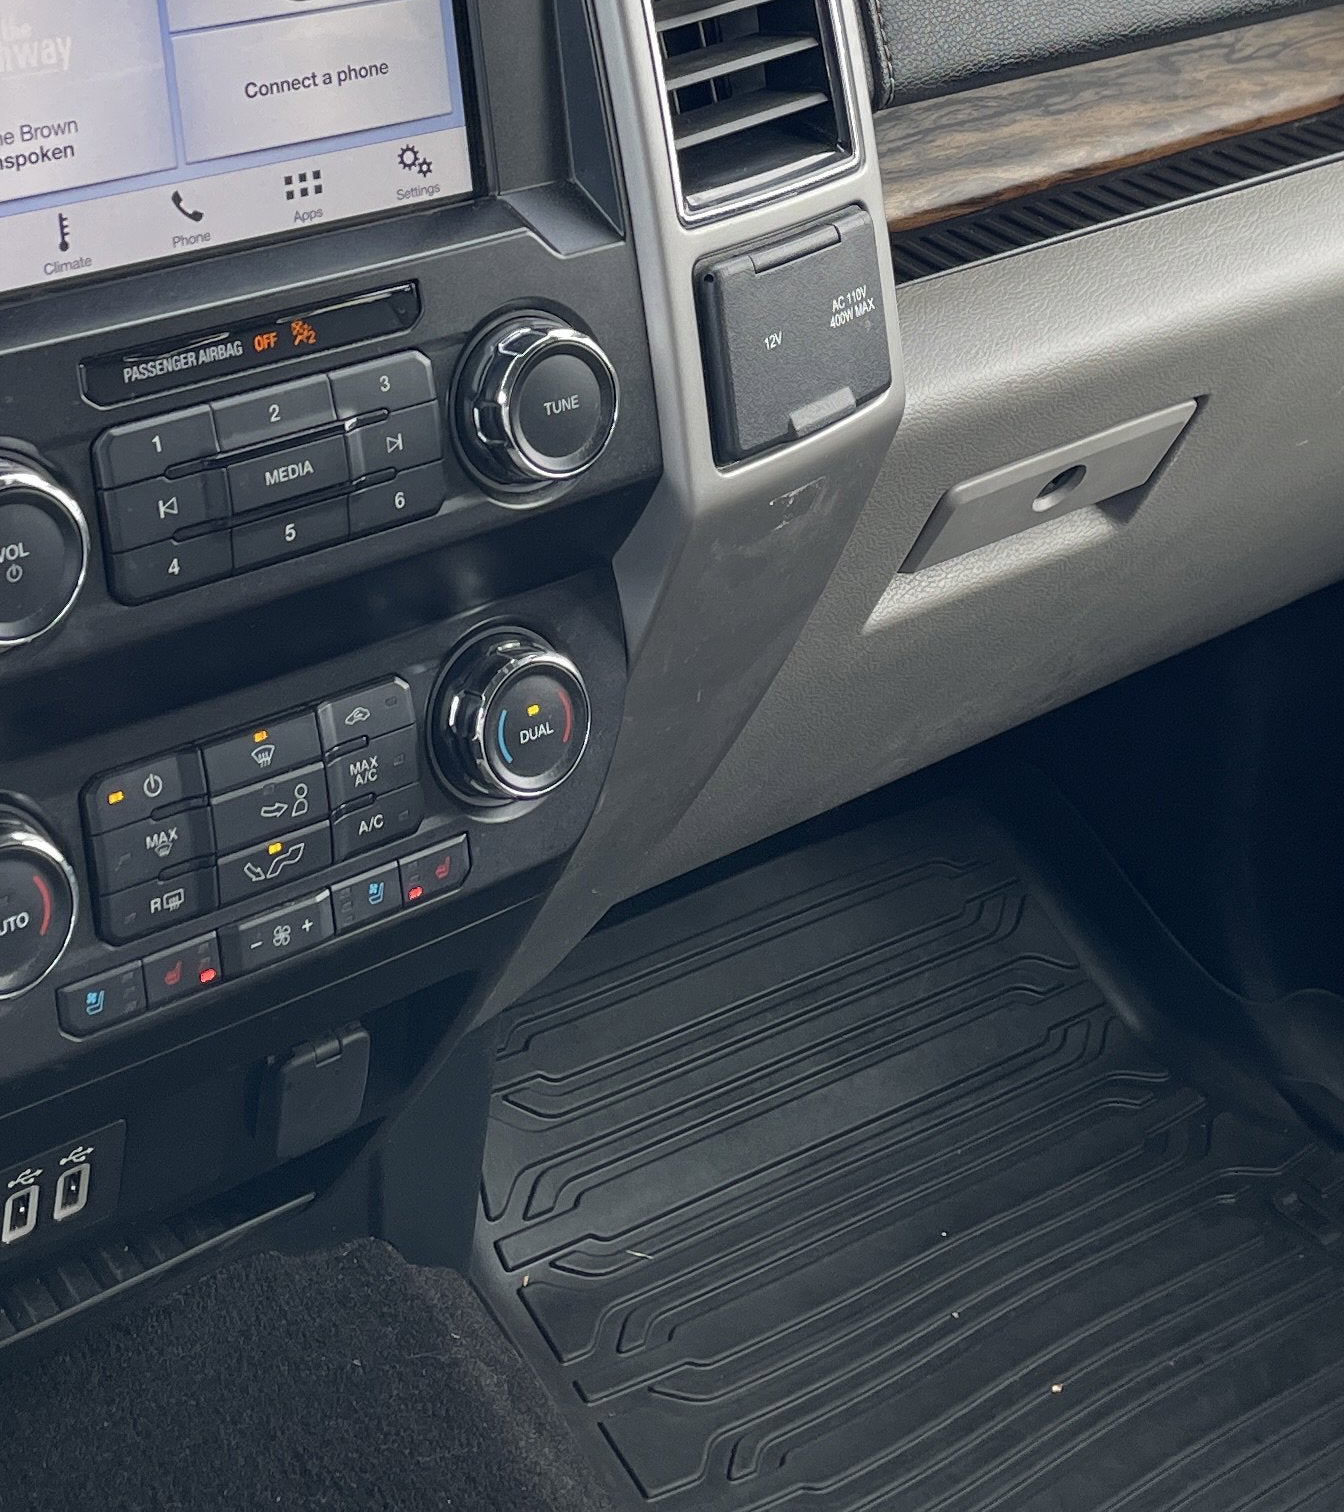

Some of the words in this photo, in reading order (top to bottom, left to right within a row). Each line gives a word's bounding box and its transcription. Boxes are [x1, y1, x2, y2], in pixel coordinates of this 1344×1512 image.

[244, 72, 318, 99] Connect
[322, 72, 332, 85] a
[336, 62, 389, 87] phone
[19, 119, 79, 143] Brown
[395, 180, 441, 203] Settings
[292, 207, 324, 225] Apps
[171, 229, 212, 247] Phone
[43, 254, 93, 277] Climate
[832, 297, 846, 312] AC
[846, 285, 867, 304] 110V
[830, 307, 854, 328] 400W
[854, 297, 875, 317] MAX
[764, 331, 782, 350] 12V
[123, 353, 197, 383] PASSENGER
[198, 341, 244, 365] AIRBAG
[253, 331, 278, 353] OFF
[379, 375, 391, 393] 3
[269, 405, 281, 422] 2
[543, 394, 580, 417] TUNE
[264, 461, 315, 487] MEDIA
[393, 492, 406, 509] 6
[284, 524, 297, 542] 5
[167, 557, 181, 575] 4
[520, 722, 554, 744] DUAL
[349, 755, 379, 776] MAX
[354, 769, 379, 788] A/C
[358, 814, 385, 836] A/C
[145, 827, 178, 850] MAX
